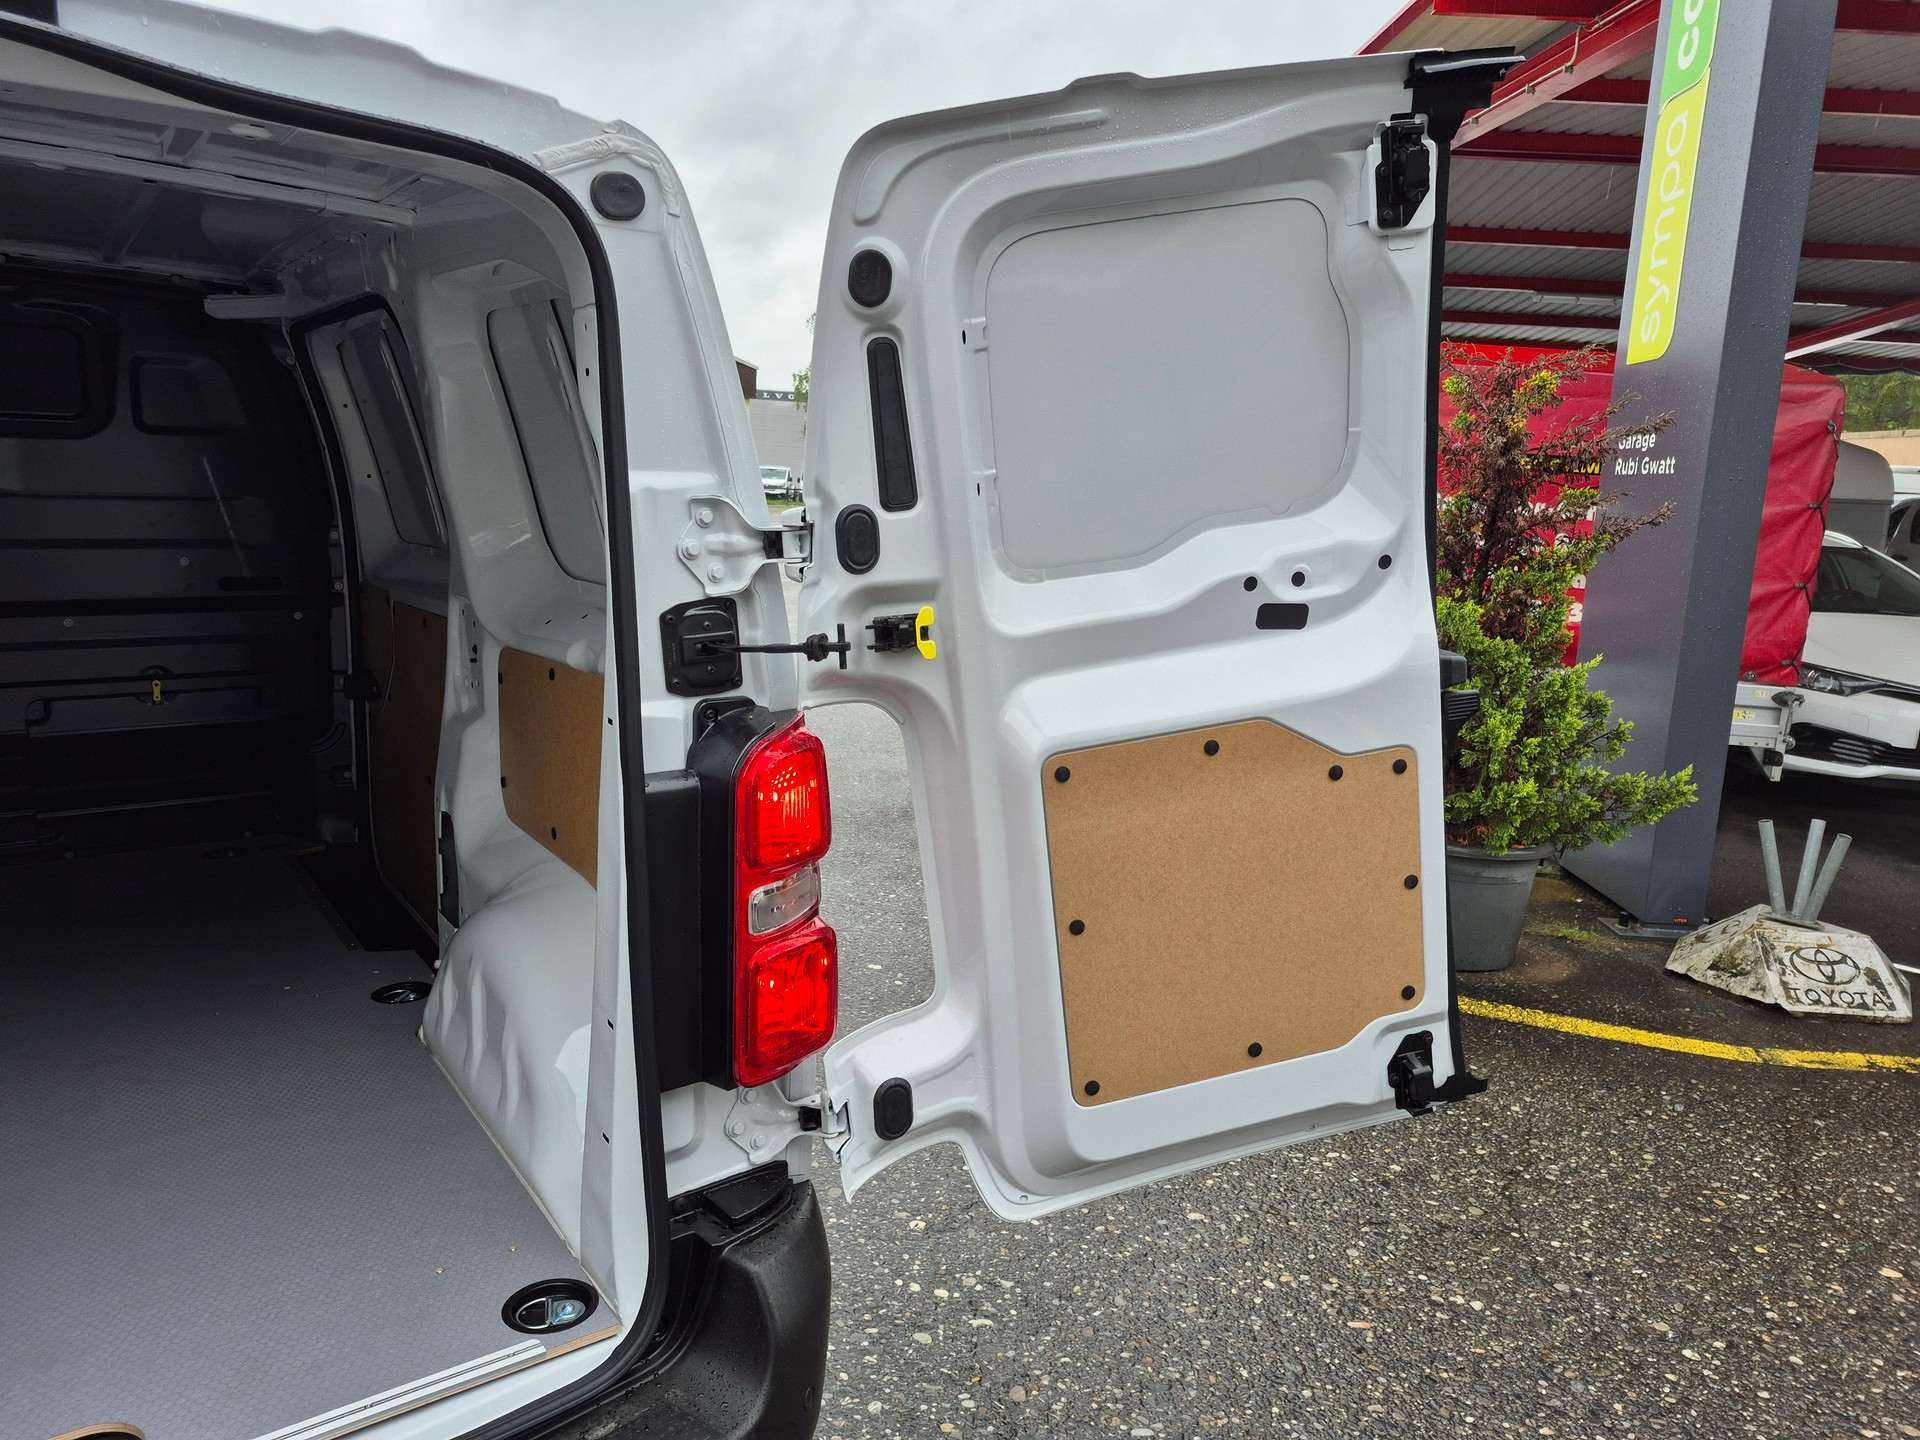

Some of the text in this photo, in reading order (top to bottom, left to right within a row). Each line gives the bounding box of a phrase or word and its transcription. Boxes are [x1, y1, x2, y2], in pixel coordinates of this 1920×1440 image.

[1641, 111, 1689, 343] sympa
[1614, 457, 1639, 476] Rubi
[1641, 456, 1676, 475] Gwatt
[1787, 987, 1893, 1011] TOYOTA
